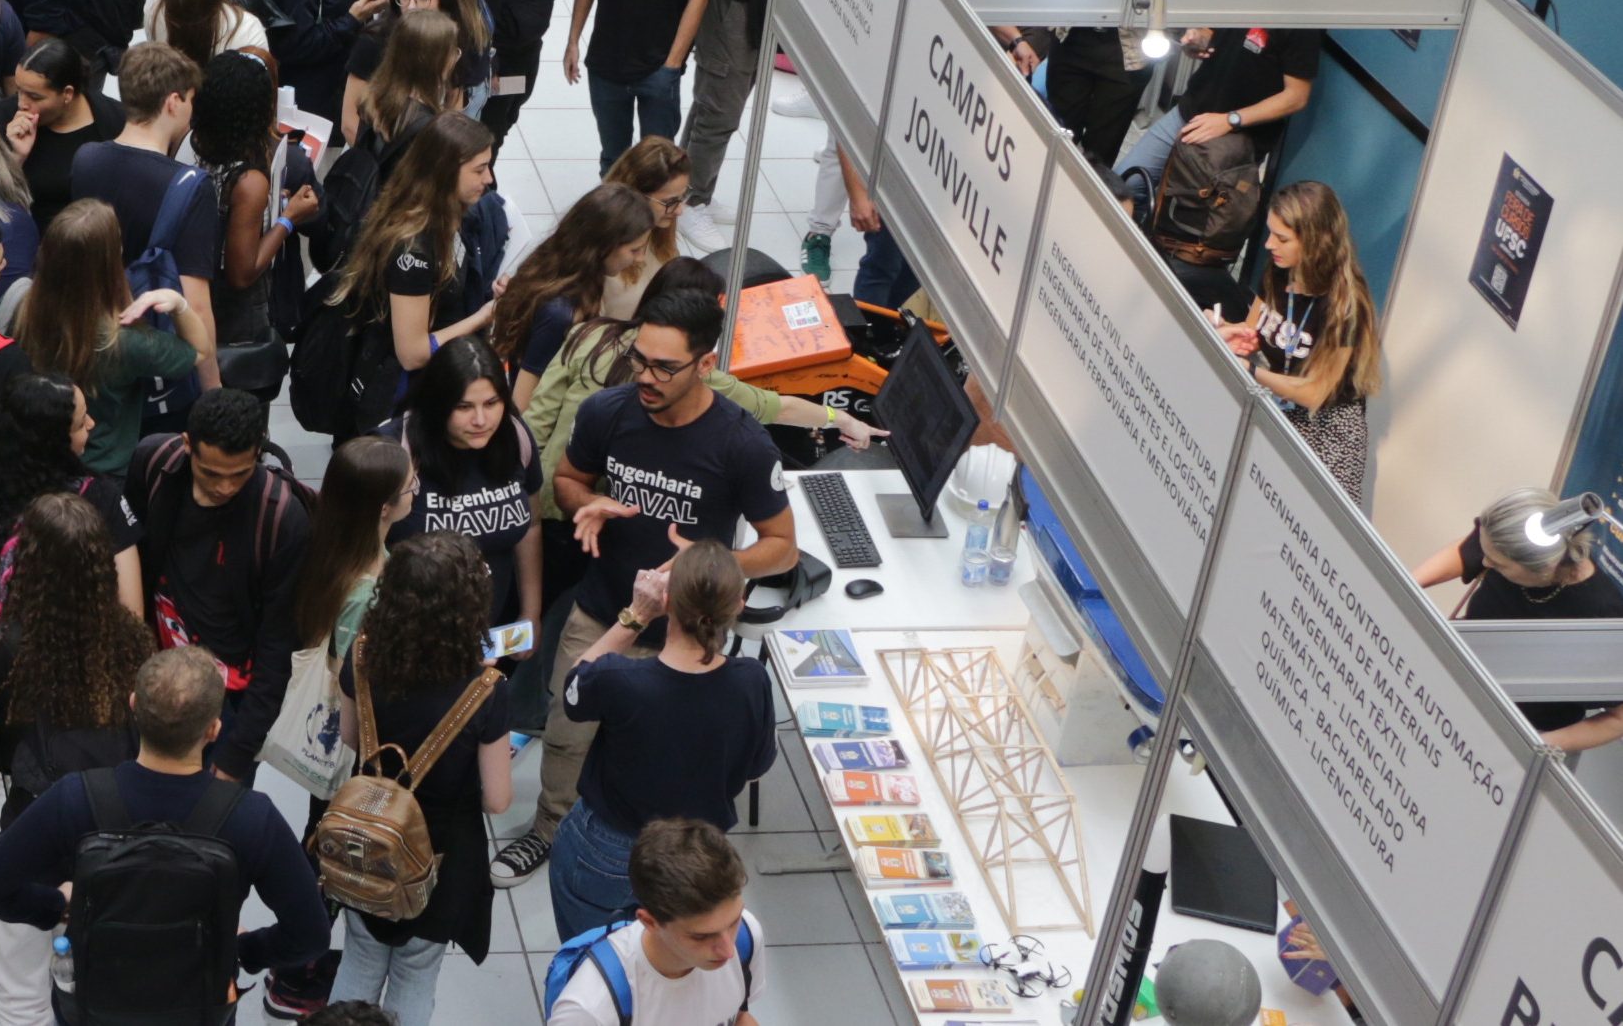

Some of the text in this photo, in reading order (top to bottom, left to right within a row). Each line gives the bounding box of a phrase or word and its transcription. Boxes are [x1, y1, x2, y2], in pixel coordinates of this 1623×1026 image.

[841, 13, 860, 46] NAVAL
[928, 33, 1016, 182] CAMPUS
[414, 259, 429, 270] EIC
[904, 95, 1008, 276] JOINVILLE
[1495, 217, 1528, 259] UFSC
[823, 390, 852, 408] RS
[1038, 285, 1086, 368] ENGENHARIA
[1085, 360, 1139, 446] FERROVIÁRIA
[1145, 450, 1207, 546] METROVIÁRIA
[1041, 260, 1090, 339] ENGENHARIA
[1090, 330, 1103, 357] DE
[1102, 347, 1161, 442] TRANSPORTES
[1168, 448, 1216, 525] LOGÍSTICA
[1050, 240, 1217, 489] ENGENHARIA CIVIL DE INSFRAESTRUTURA
[425, 498, 532, 537] NAVAL
[427, 480, 522, 512] Engenharia
[606, 454, 703, 501] Engenharia
[607, 473, 698, 525] NAVAL
[1249, 461, 1504, 807] ENGENHARIA DE CONTROLE E AUTOMAÇÃO
[1258, 589, 1427, 837] MATEMÁTICA LICENCIATURA
[1279, 542, 1441, 769] ENGENHARIA DE MATERIAIS
[1290, 595, 1408, 768] ENGENHARIA TÊXTIL
[1255, 660, 1394, 873] QUÍMICA LICENCIATURA
[1260, 630, 1405, 843] QUÍMICA BACHARELADO
